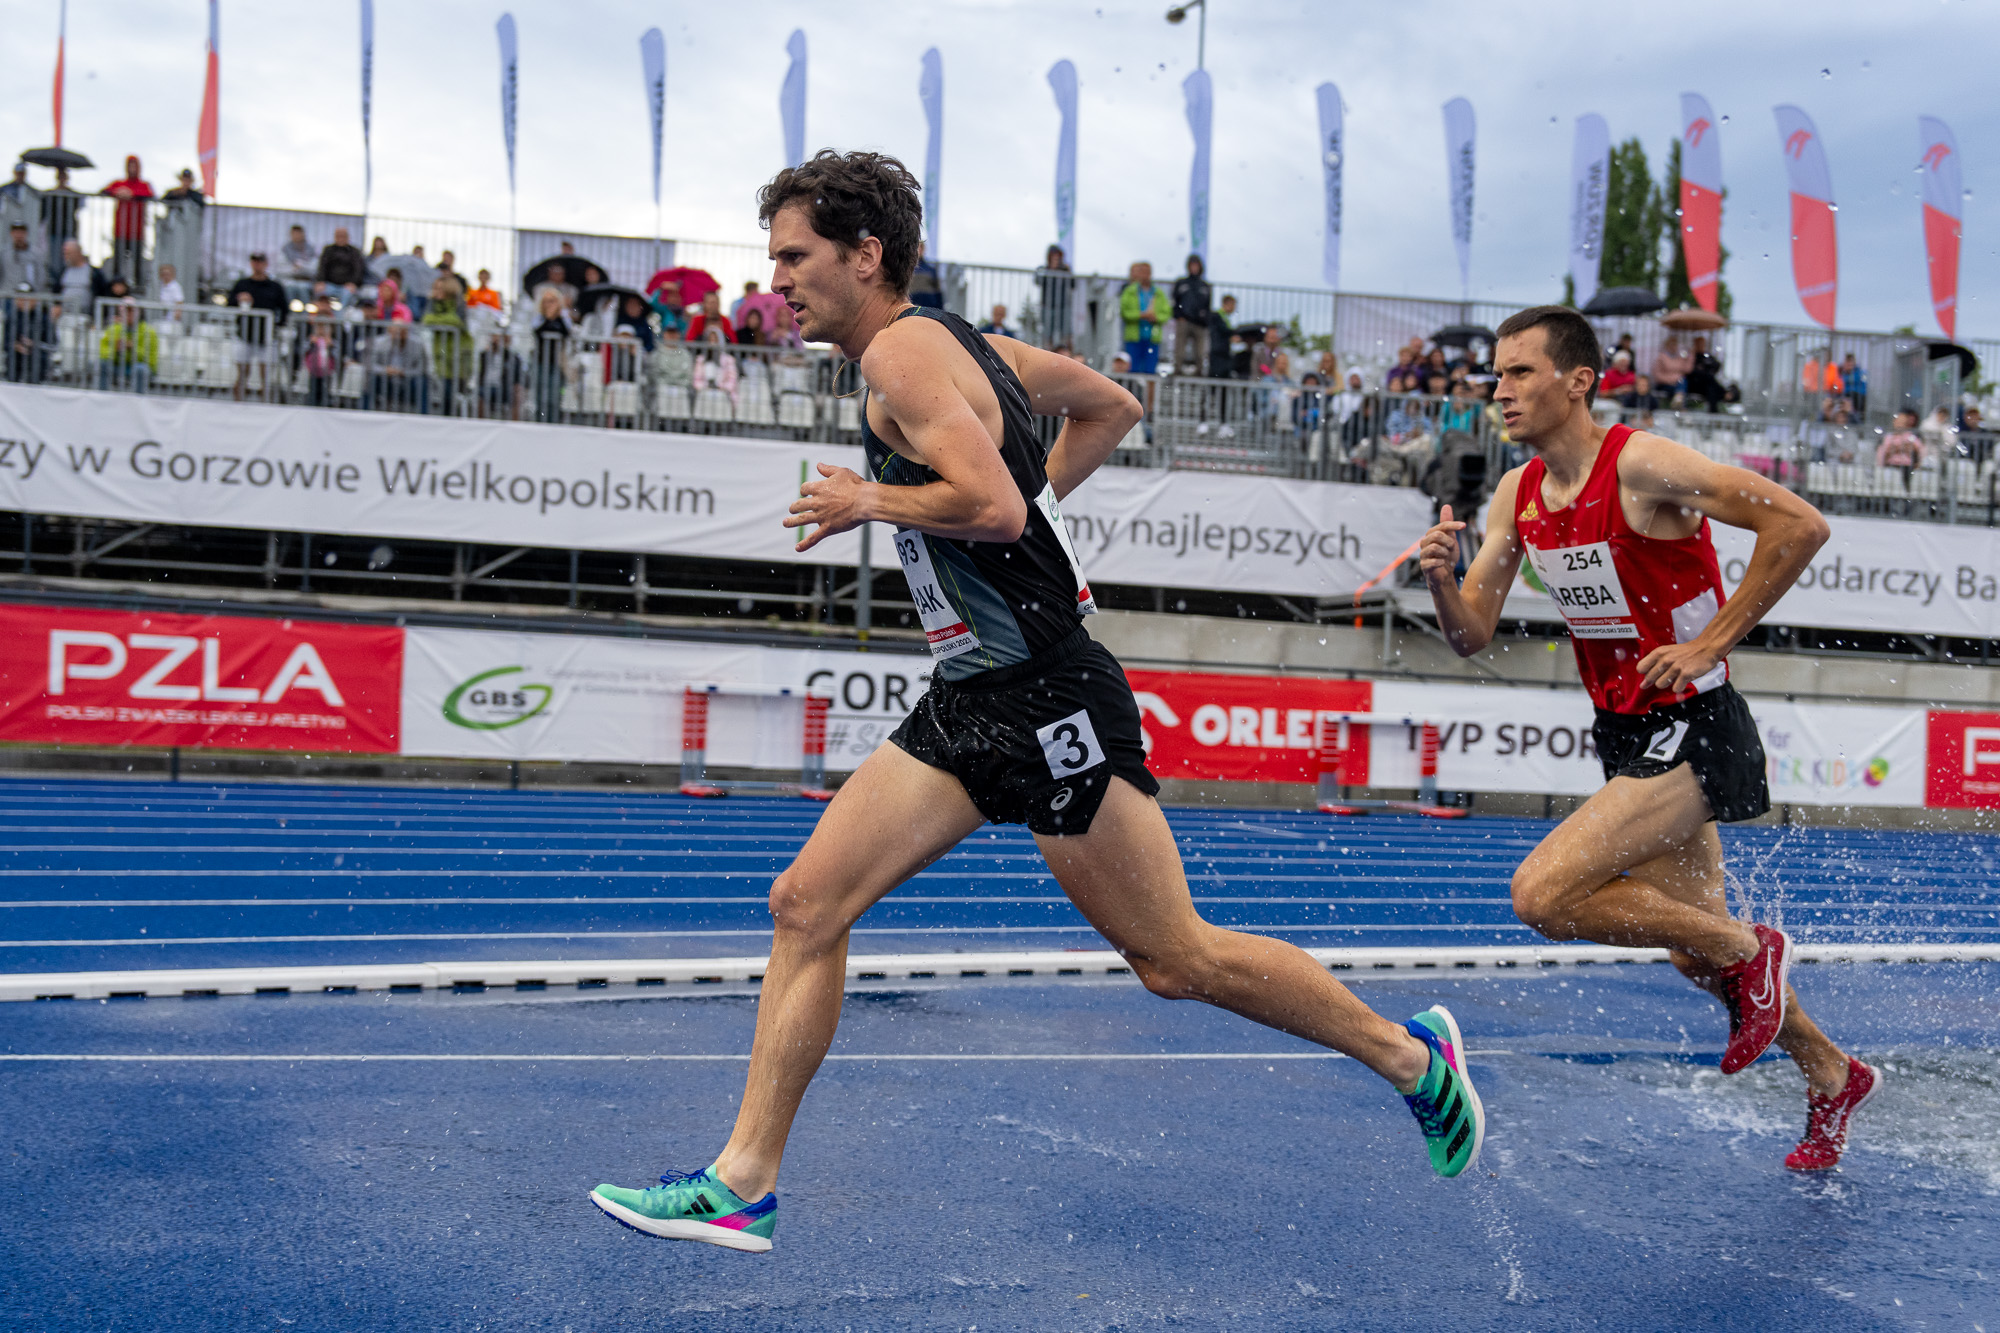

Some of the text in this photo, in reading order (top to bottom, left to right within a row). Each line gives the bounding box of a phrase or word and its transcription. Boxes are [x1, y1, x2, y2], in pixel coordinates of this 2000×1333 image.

[0, 438, 716, 516] zy w Gorzowie Wielkopolskim
[897, 538, 919, 567] 93
[1129, 513, 1362, 567] najlepszych
[1563, 549, 1603, 571] 254
[911, 583, 945, 615] AK
[1957, 566, 1998, 600] Ba
[49, 629, 346, 707] PZLA
[469, 690, 528, 707] GBS
[805, 669, 933, 712] GOR
[1052, 722, 1089, 769] 3
[1496, 723, 1598, 758] SPOR
[1650, 724, 1676, 757] 2
[1767, 726, 1791, 749] for
[1766, 756, 1859, 788] TER KIDS
